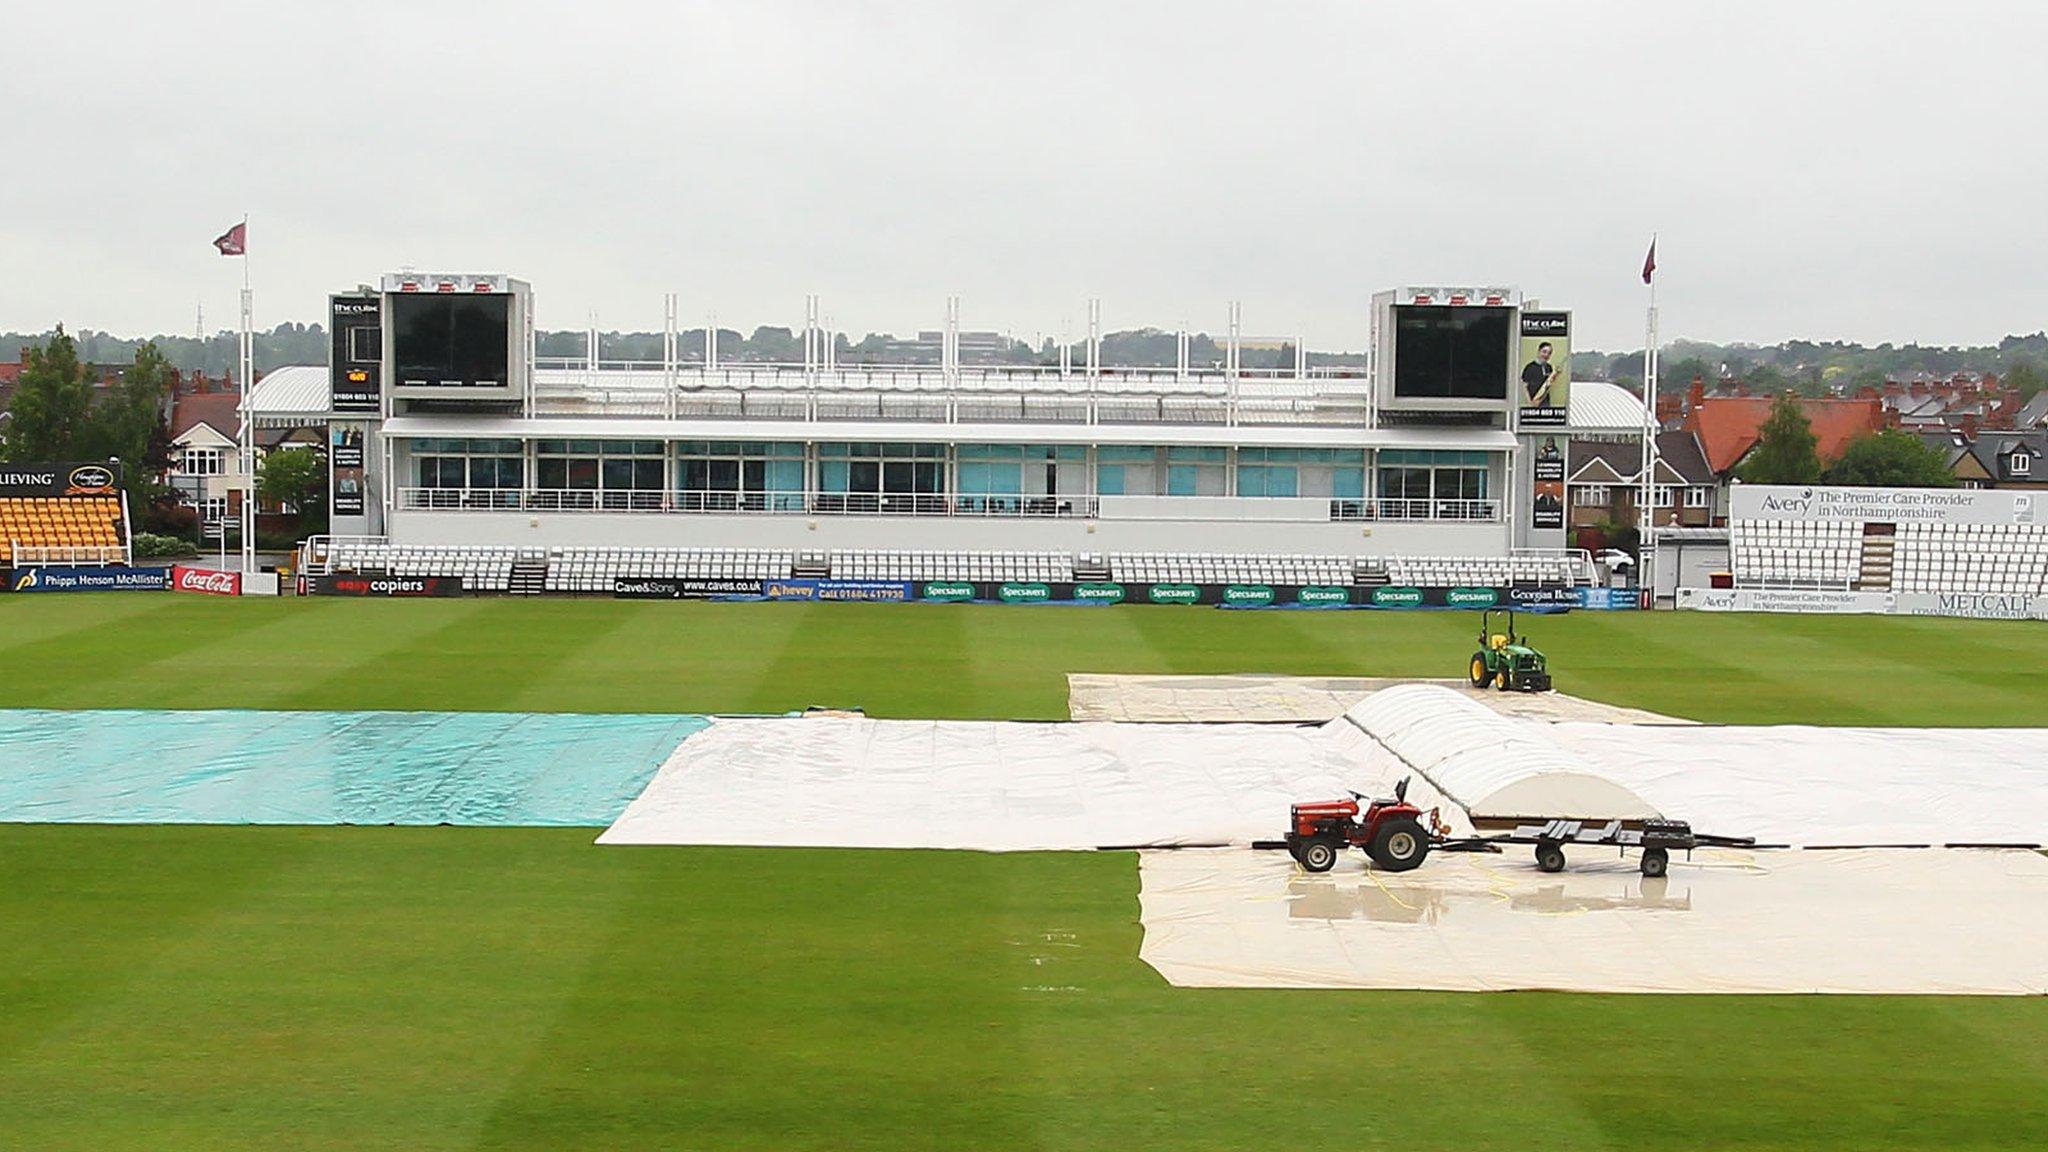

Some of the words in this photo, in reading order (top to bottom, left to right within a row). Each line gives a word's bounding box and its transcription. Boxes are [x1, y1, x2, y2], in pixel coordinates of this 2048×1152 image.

[1761, 494, 1812, 517] Avery
[1819, 491, 1840, 503] The
[1843, 492, 1890, 504] Premier
[1892, 494, 1920, 505] Care
[1922, 494, 1974, 506] Provider
[1819, 505, 1830, 516] in
[1832, 505, 1946, 519] Northamptonshire
[45, 575, 77, 587] Phipps
[79, 575, 114, 585] Henson
[116, 574, 163, 585] McAllister
[683, 580, 761, 591] www.caves.co.uk
[818, 589, 838, 598] Call
[840, 589, 868, 598] 01604
[927, 586, 970, 597] Specsavers
[1003, 586, 1046, 598] Specsavers
[1078, 587, 1120, 598] Specsavers
[1153, 587, 1196, 599] Specsavers
[1227, 588, 1270, 600] Specsavers
[1302, 589, 1345, 601] Specsavers
[1376, 591, 1419, 602] Specsavers
[1451, 591, 1493, 602] Specsavers
[1753, 592, 1768, 601] The
[1770, 593, 1797, 602] Premier
[1799, 594, 1819, 602] Care
[1821, 594, 1857, 603] Provider
[1939, 594, 2032, 611] METCALF
[1762, 602, 1838, 612] Northamptonshire
